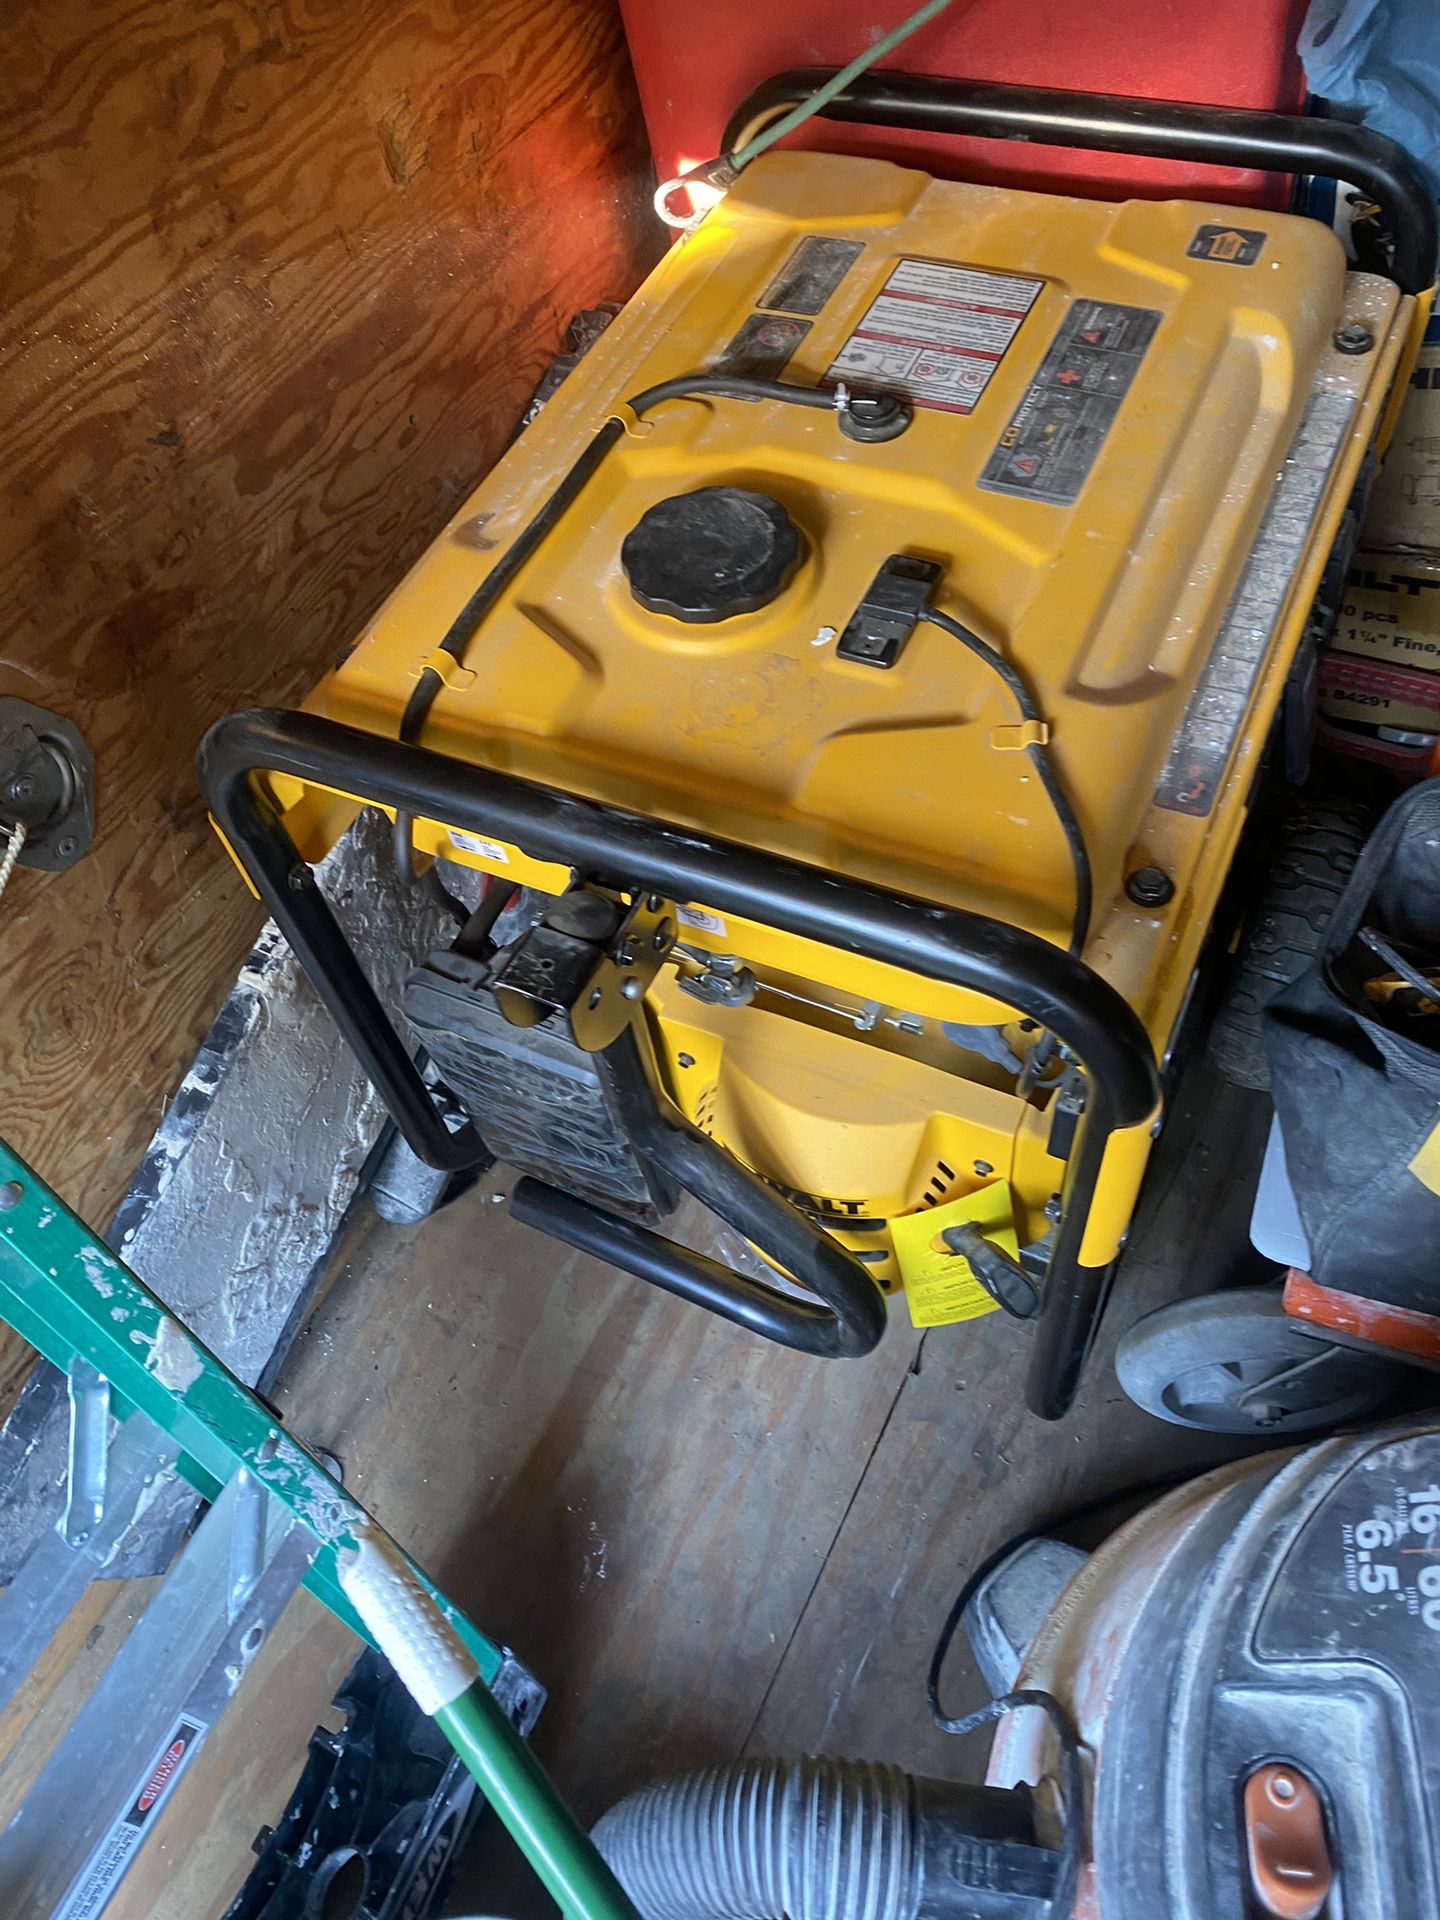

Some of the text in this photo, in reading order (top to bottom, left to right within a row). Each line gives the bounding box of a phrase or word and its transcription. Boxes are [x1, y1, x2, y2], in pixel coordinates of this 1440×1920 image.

[1362, 611, 1398, 623] pcs
[1333, 689, 1390, 708] 84291
[786, 1189, 865, 1214] ALT
[1355, 1519, 1400, 1594] 6.5
